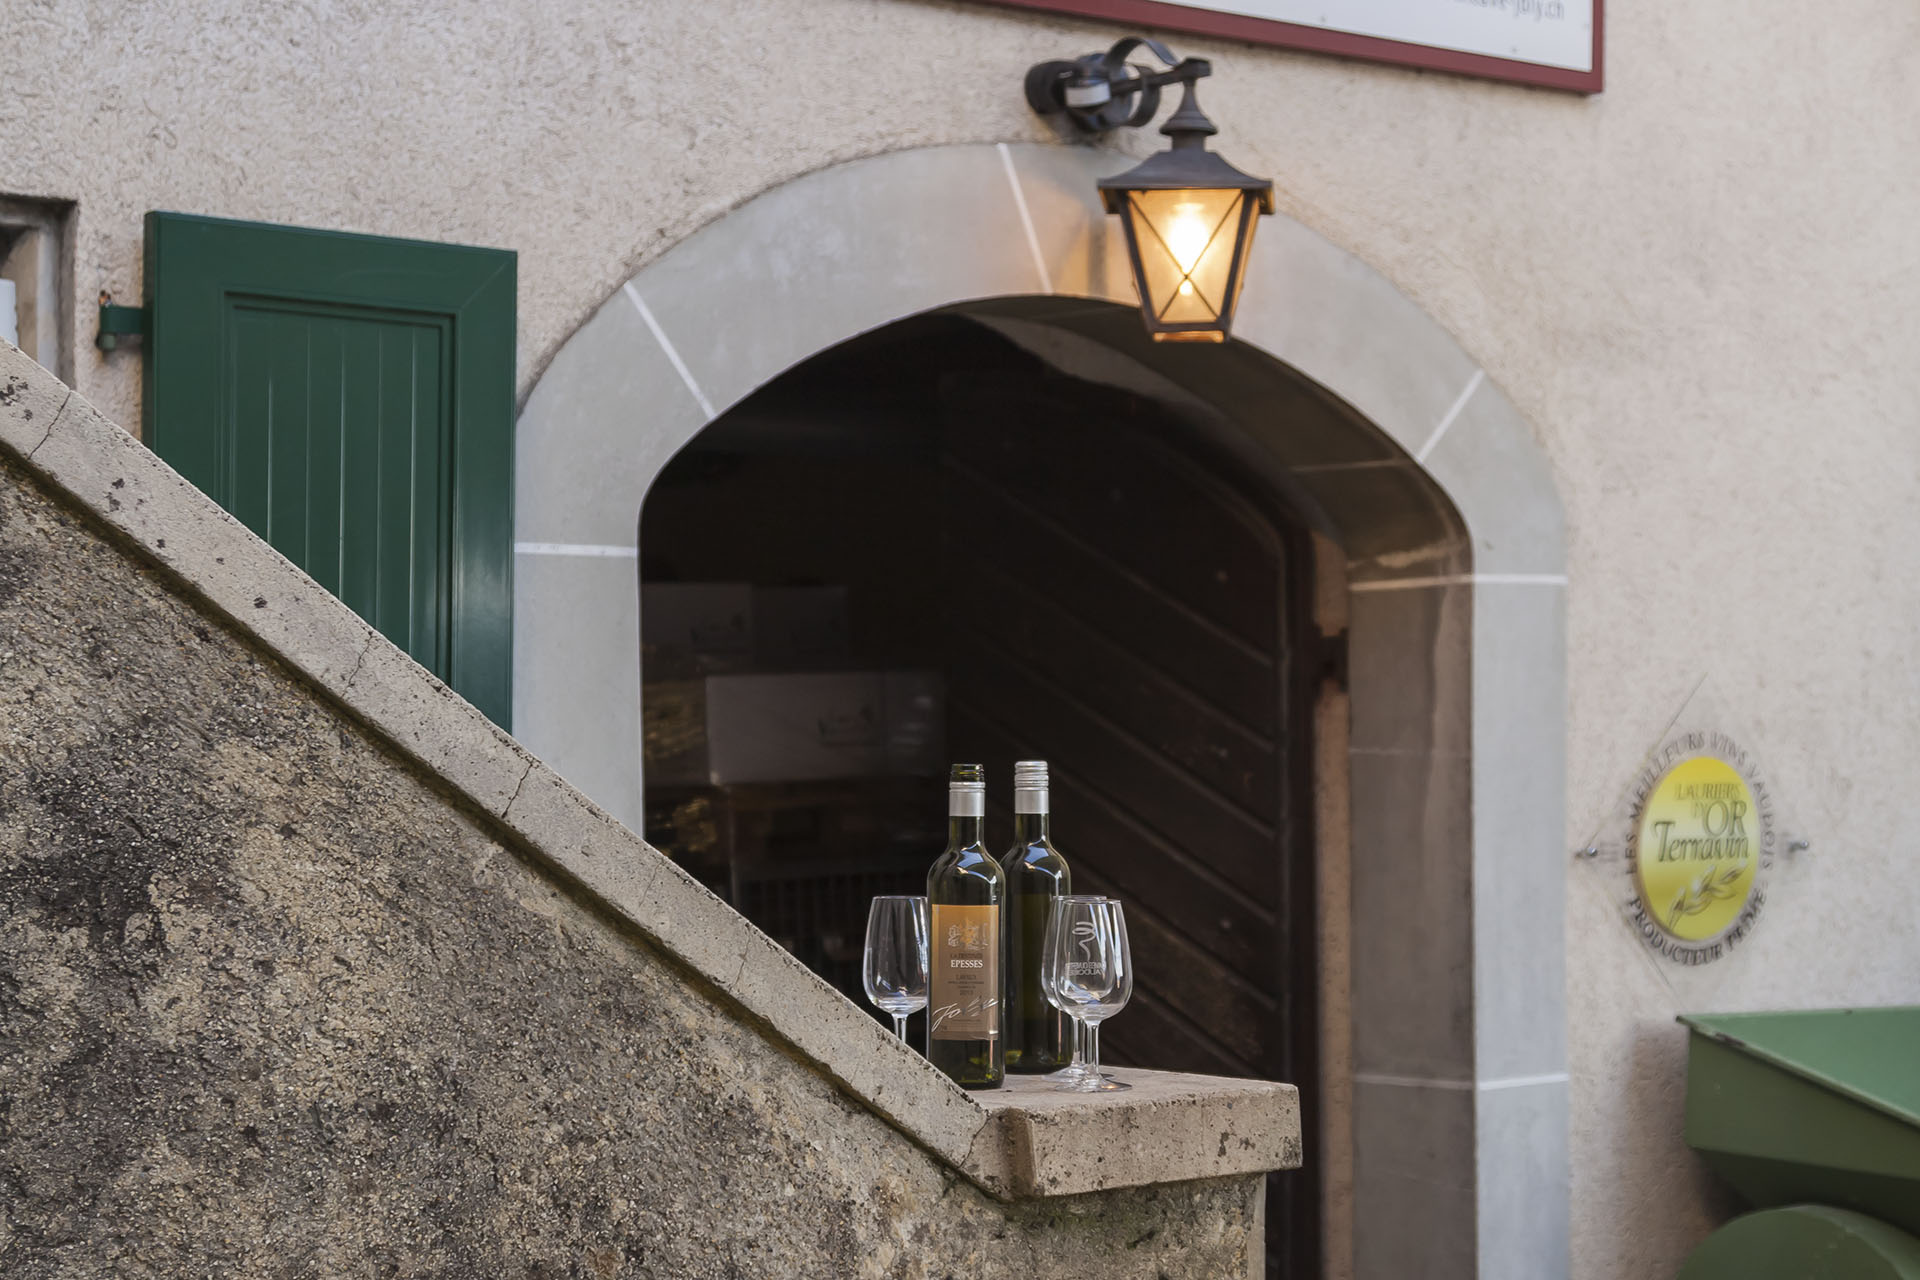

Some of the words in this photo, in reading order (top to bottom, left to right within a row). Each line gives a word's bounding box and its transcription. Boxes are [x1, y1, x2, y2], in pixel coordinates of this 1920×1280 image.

[1630, 732, 1705, 820] MEILLEURS
[1710, 731, 1748, 764] VINS
[1746, 762, 1776, 870] VAUDOIS
[1654, 820, 1750, 863] Terravin
[1628, 895, 1723, 966] PRODUCTEUR
[950, 959, 984, 968] EPESSES
